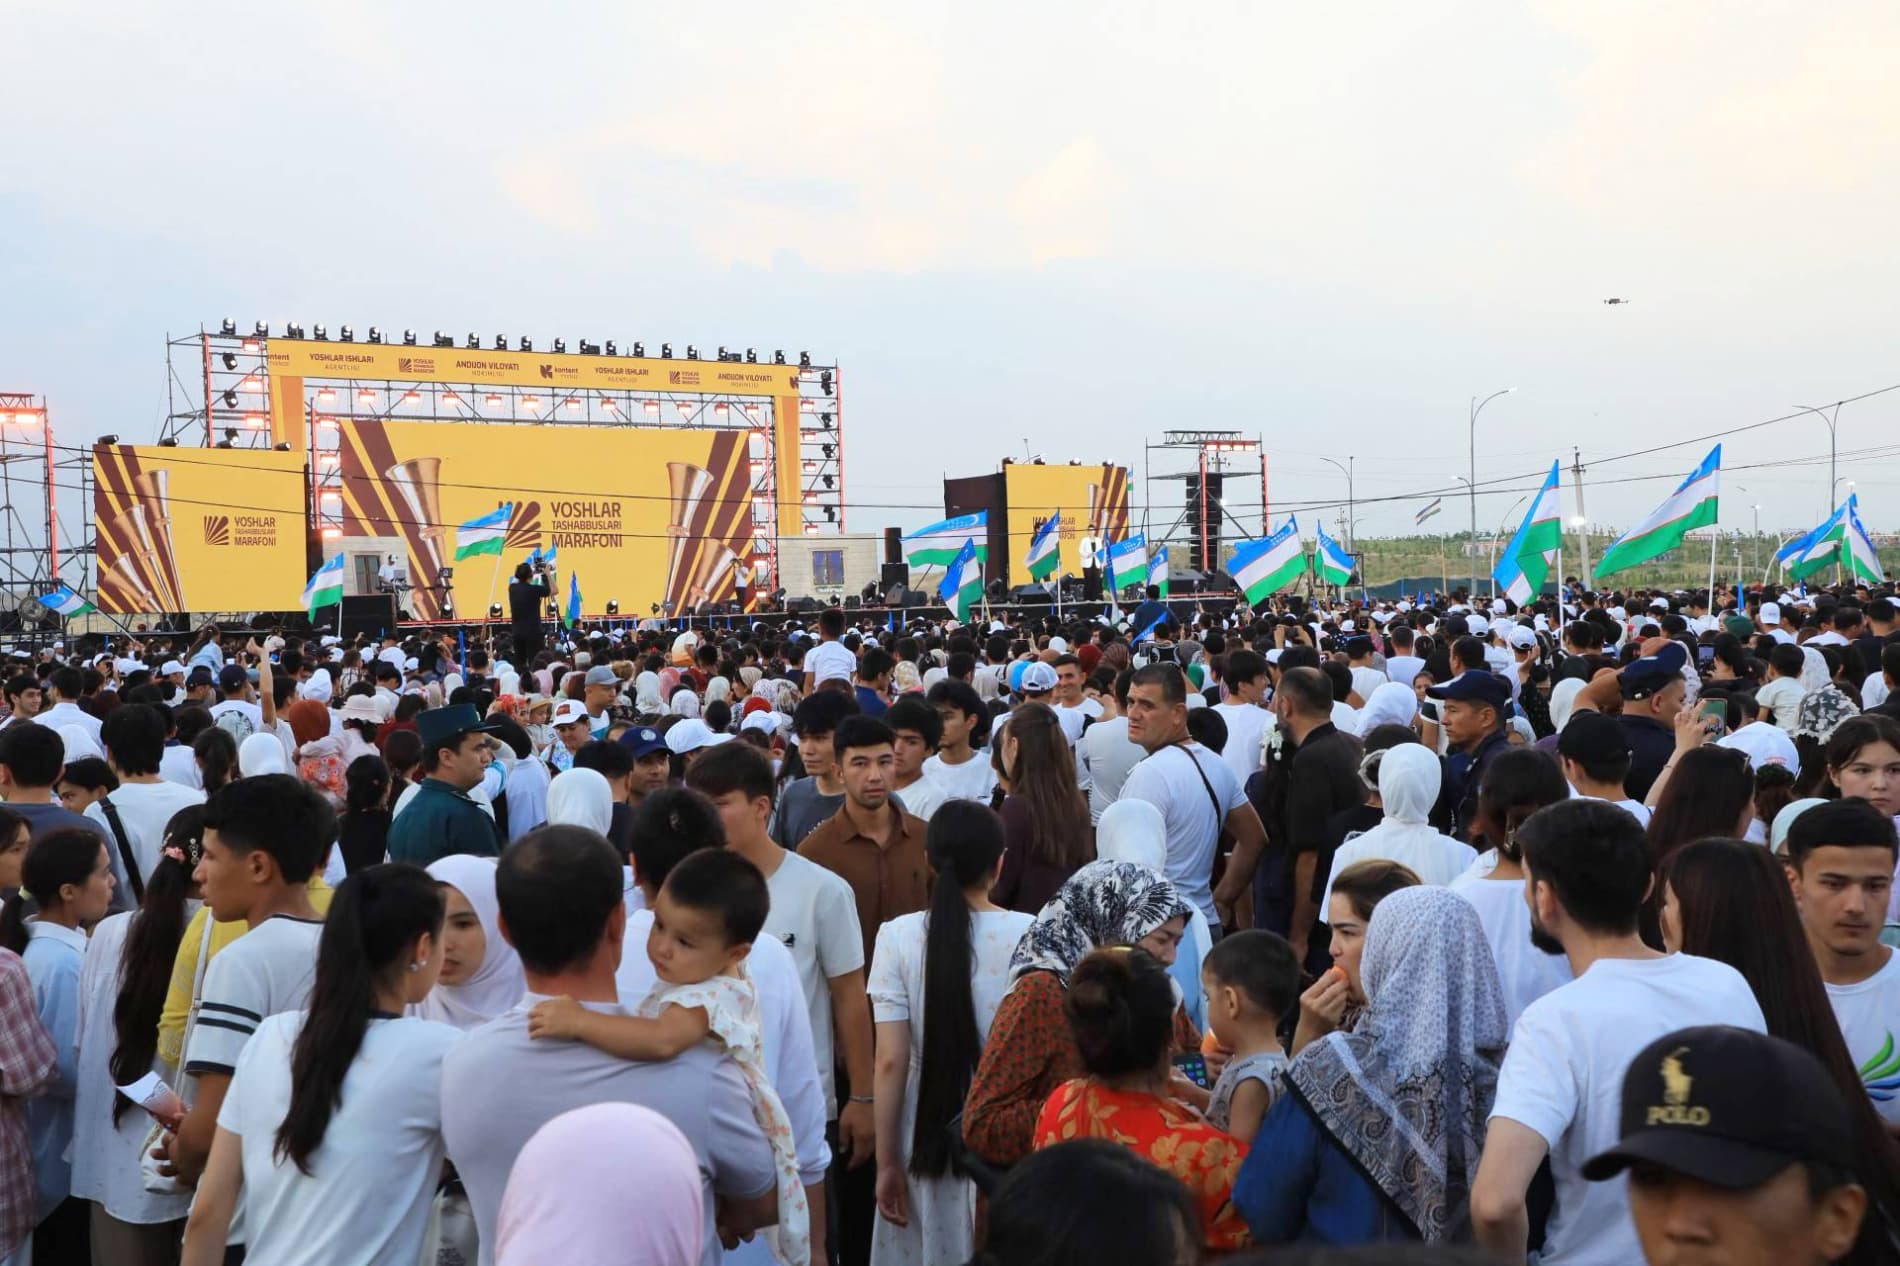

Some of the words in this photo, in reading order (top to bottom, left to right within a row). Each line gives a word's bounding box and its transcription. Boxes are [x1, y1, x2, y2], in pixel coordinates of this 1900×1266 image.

[267, 353, 289, 361] ontent
[309, 353, 344, 362] YOSHLAR
[345, 354, 374, 363] ISHLARI
[456, 360, 487, 370] ANDIJON
[489, 361, 520, 371] VILOYATI
[595, 367, 624, 375] YOSHLAR
[625, 368, 649, 377] ISHLARI
[718, 373, 744, 381] ANDIJON
[745, 375, 773, 383] VILOYATI
[551, 501, 621, 518] YOSHLAR
[234, 516, 276, 527] YOSHLAR
[551, 520, 622, 530] TASHABBUSLARI
[234, 536, 276, 546] MARAFONI
[551, 533, 623, 548] MARAFONI
[1646, 1106, 1710, 1126] POLO
